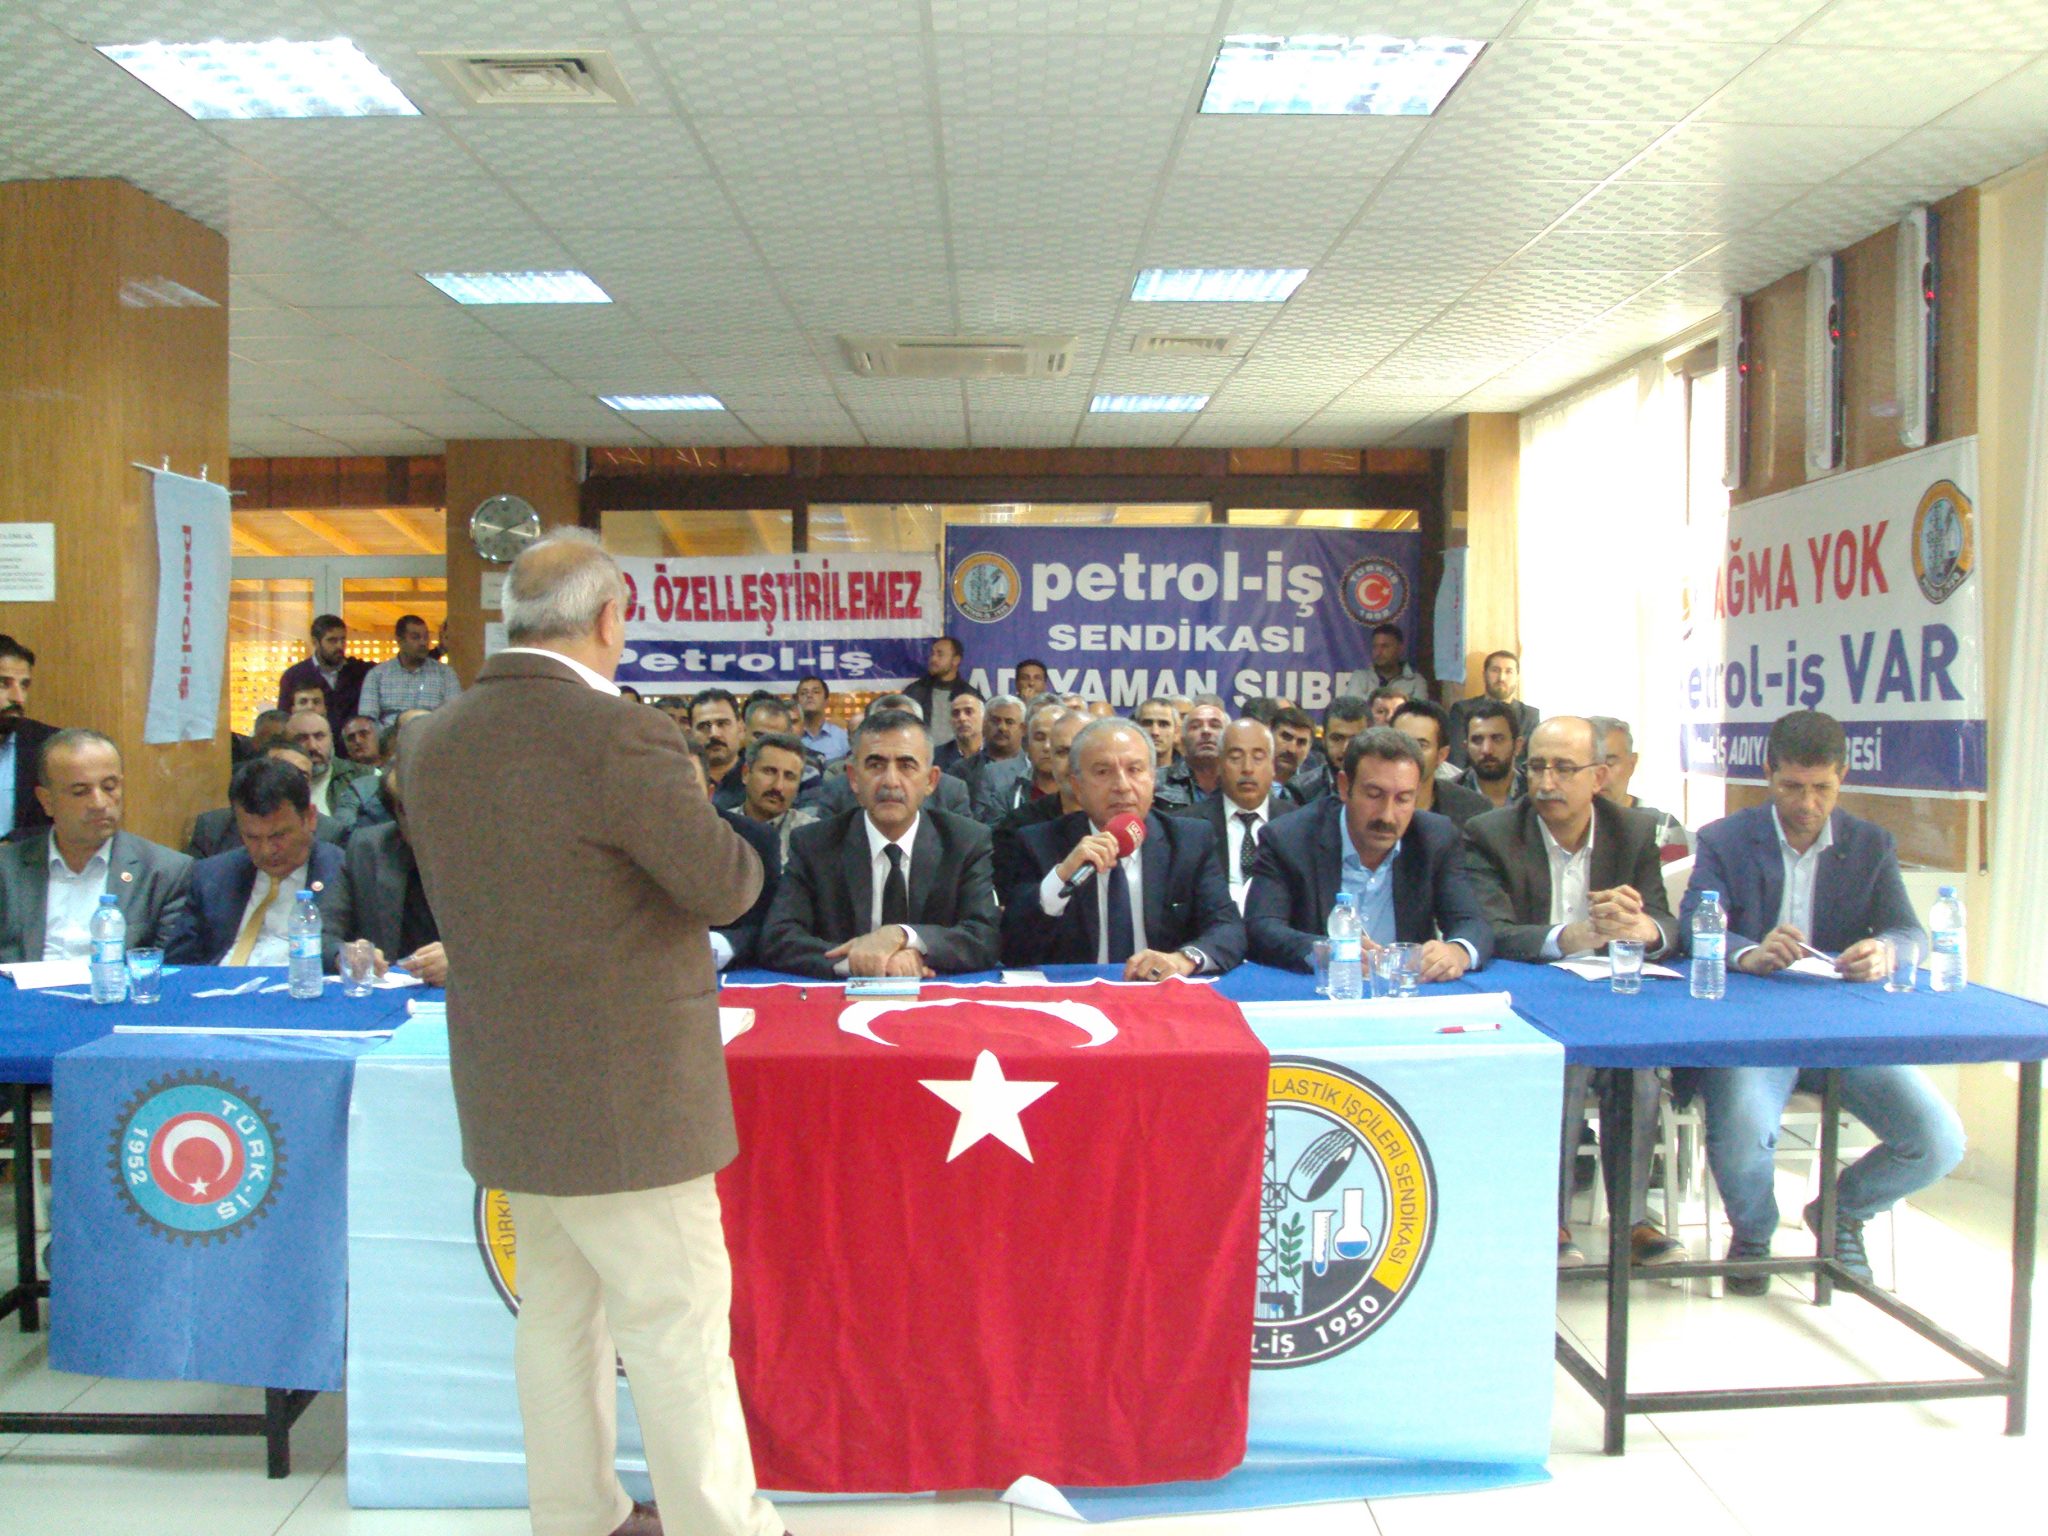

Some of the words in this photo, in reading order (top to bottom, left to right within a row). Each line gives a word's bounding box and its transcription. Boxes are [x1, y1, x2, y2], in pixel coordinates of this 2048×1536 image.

[1032, 551, 1324, 618] petrol-iş
[1808, 519, 1890, 604] YOK
[653, 559, 922, 636] ÖZELLEŞTİRİLEMEZ
[1047, 618, 1305, 653] SENDİKASI
[968, 667, 1218, 708] ADYAMAN
[1680, 639, 1826, 712] etrol-iş
[1840, 623, 1965, 704] VAR
[1728, 735, 1769, 766] ADIY
[1844, 727, 1883, 771] ESİ
[127, 1126, 149, 1186] 1952
[1272, 1078, 1341, 1105] LASTİK
[1341, 1092, 1407, 1162] İŞÇİLERİ
[1387, 1162, 1416, 1265] SENDİKASI
[1315, 1294, 1380, 1344] 1950
